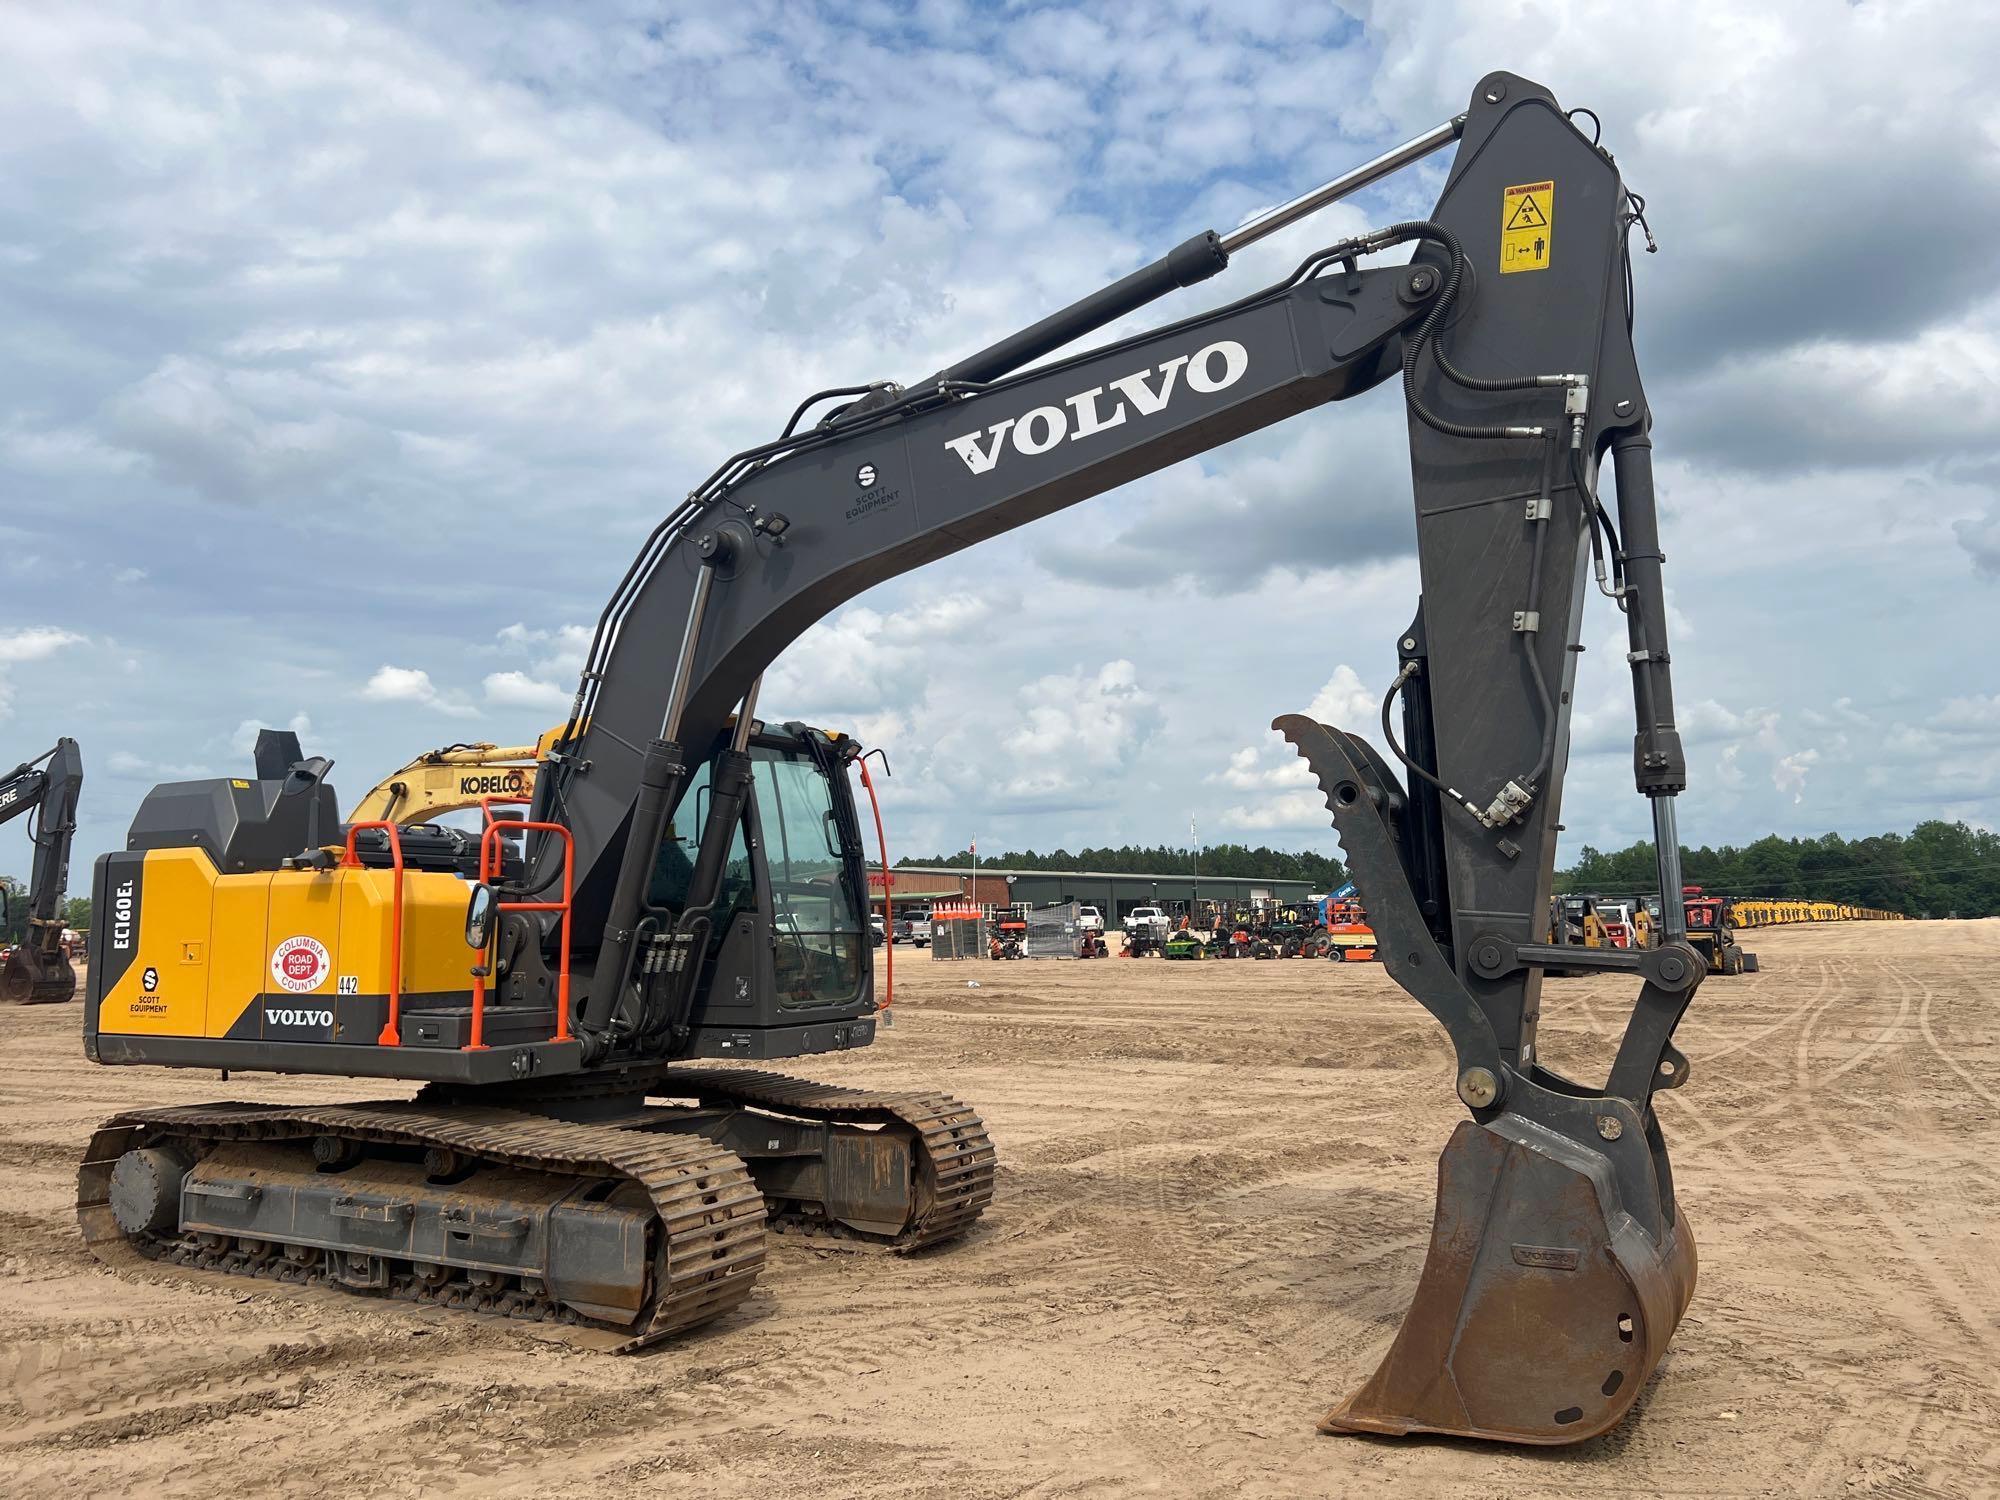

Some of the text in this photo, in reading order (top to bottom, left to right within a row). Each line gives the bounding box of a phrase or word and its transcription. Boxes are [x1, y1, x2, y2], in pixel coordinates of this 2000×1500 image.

[1516, 184, 1550, 194] WARNING
[944, 340, 1249, 475] VOLVO
[855, 486, 887, 506] SCOTT
[845, 490, 900, 519] EQUIPMENT
[460, 775, 522, 794] KOBELCO
[278, 938, 323, 959] COLUMBIA
[288, 954, 313, 964] ROAD
[288, 965, 313, 975] DEPT.
[281, 976, 318, 991] COUNTY
[339, 977, 357, 993] 442
[138, 996, 160, 1004] SCOTT
[130, 1005, 168, 1013] EQUIPMENT
[265, 1009, 334, 1026] VOLVO
